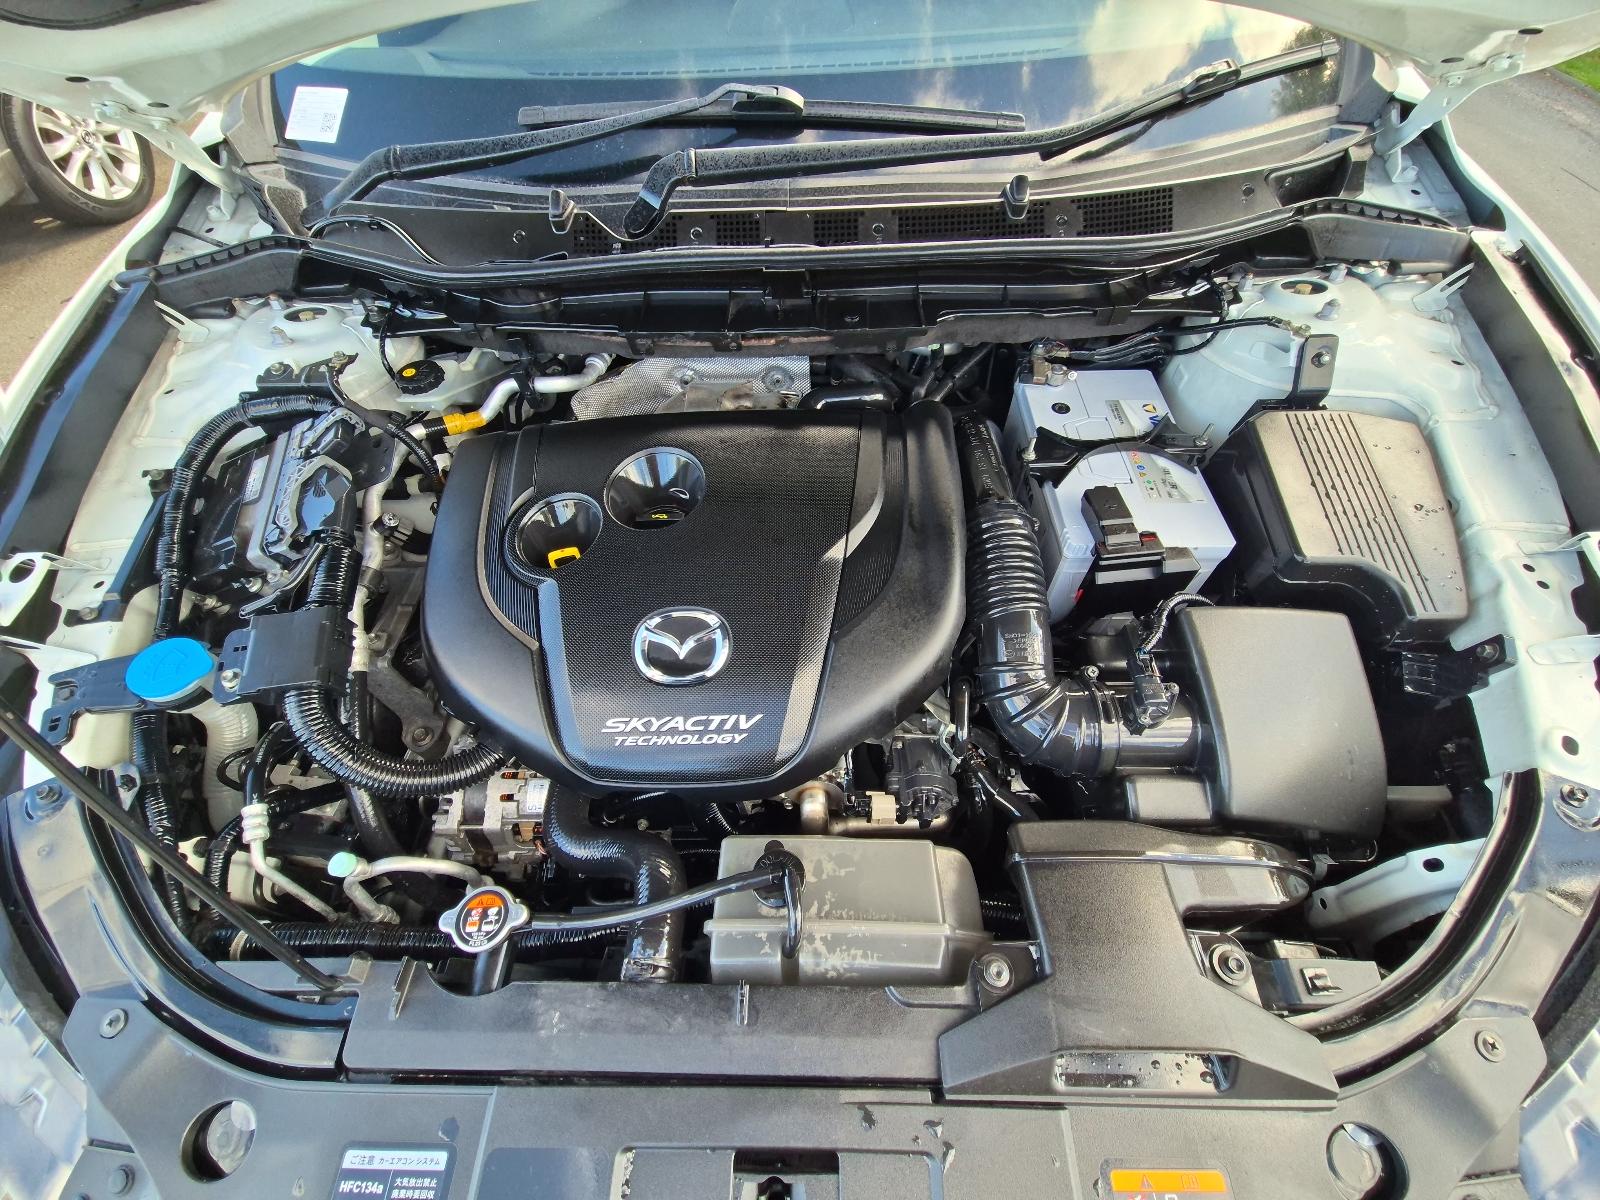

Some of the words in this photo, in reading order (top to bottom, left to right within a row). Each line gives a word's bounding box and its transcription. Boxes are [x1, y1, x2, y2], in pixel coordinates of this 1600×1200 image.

[601, 714, 764, 733] SKYACTIV
[614, 733, 749, 747] TECHNOLOGY
[350, 1154, 376, 1166] ご注意
[339, 1180, 384, 1195] HFC134a
